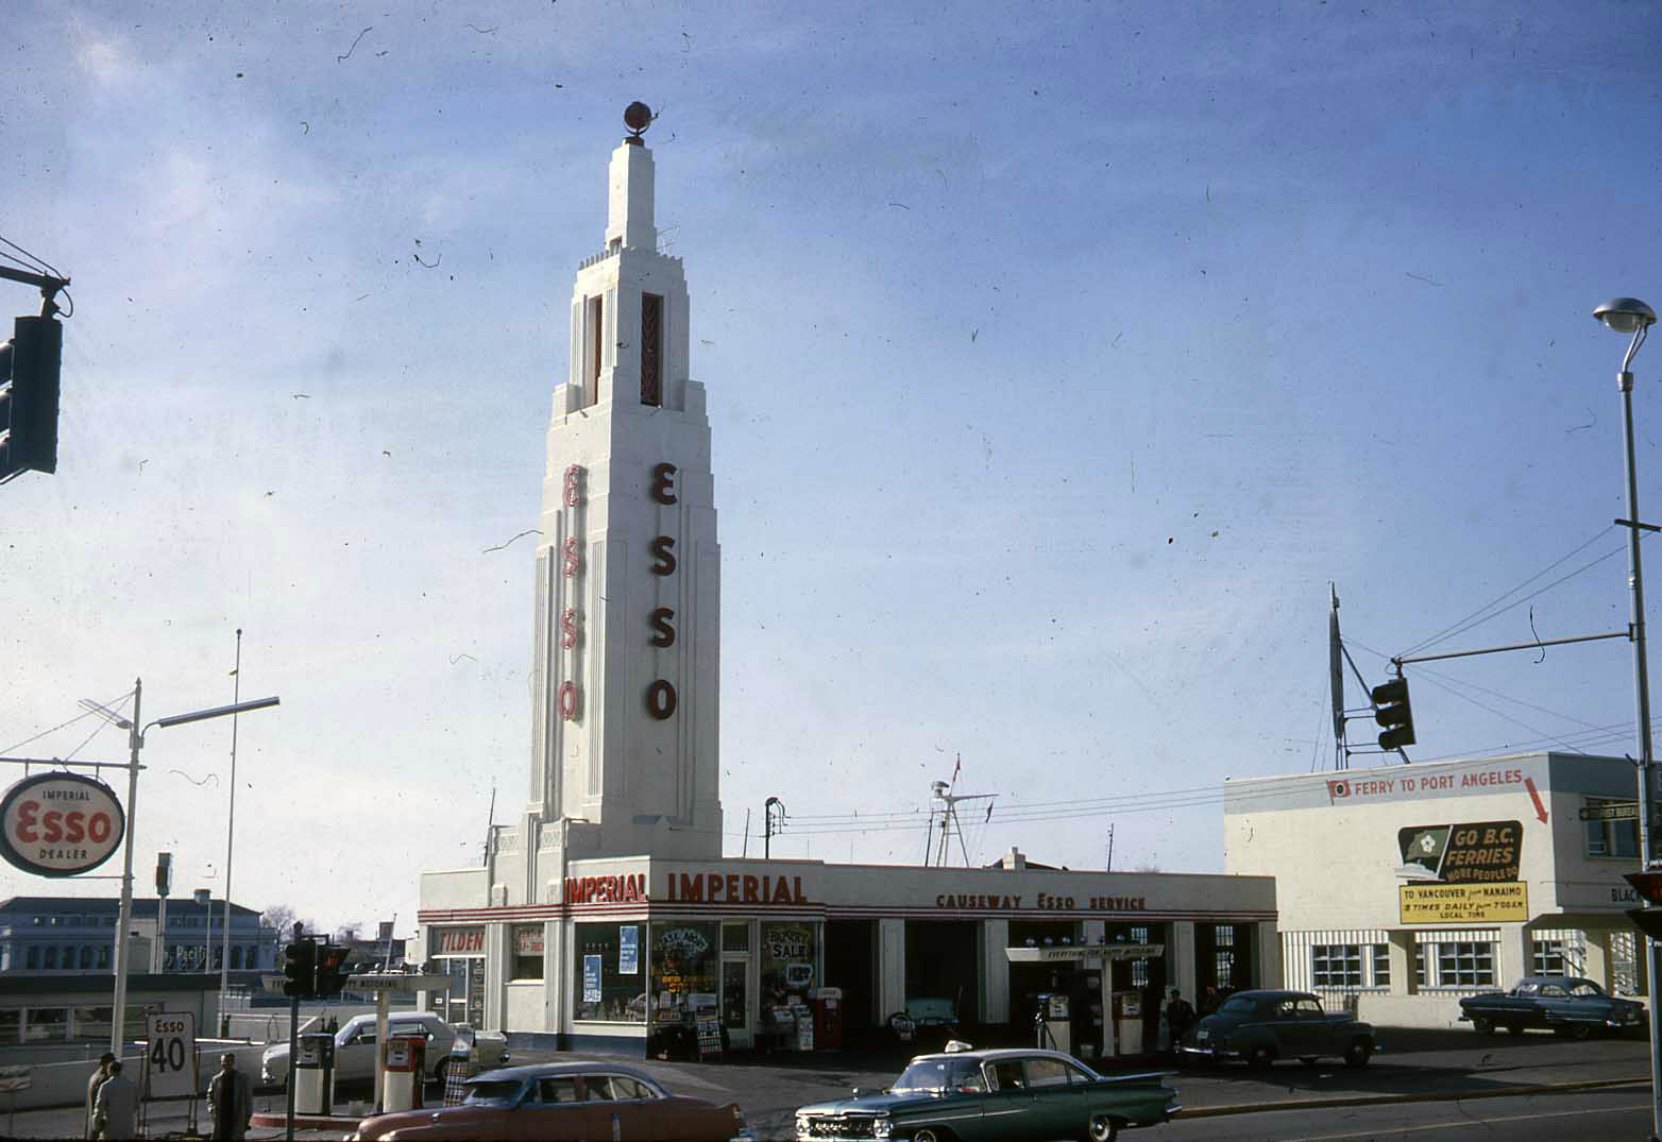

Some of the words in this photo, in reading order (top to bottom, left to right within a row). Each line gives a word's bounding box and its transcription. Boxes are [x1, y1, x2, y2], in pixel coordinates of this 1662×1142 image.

[1355, 780, 1394, 795] FERRY
[1401, 779, 1415, 792] TO
[1421, 775, 1454, 790] PORT
[1461, 769, 1522, 787] ANGELES
[42, 790, 90, 801] IMPERIAL
[1455, 830, 1477, 846] GO
[1484, 828, 1514, 844] B.C.
[39, 850, 88, 859] DEALER
[1445, 847, 1513, 865] FERRIES
[1472, 868, 1505, 880] PEOPLE
[564, 873, 649, 904] IMPERIAL
[667, 873, 807, 902] IMPERIAL
[1405, 890, 1415, 900] TO
[1418, 889, 1466, 899] VANCOUVER
[1483, 887, 1521, 897] NANAIMO
[936, 894, 1022, 910] CAUSEWAY
[1090, 897, 1146, 910] SERVICE
[1413, 903, 1440, 911] TIMES
[1445, 902, 1475, 910] DAILY
[441, 932, 485, 952] TILDEN
[151, 1037, 185, 1073] 40
